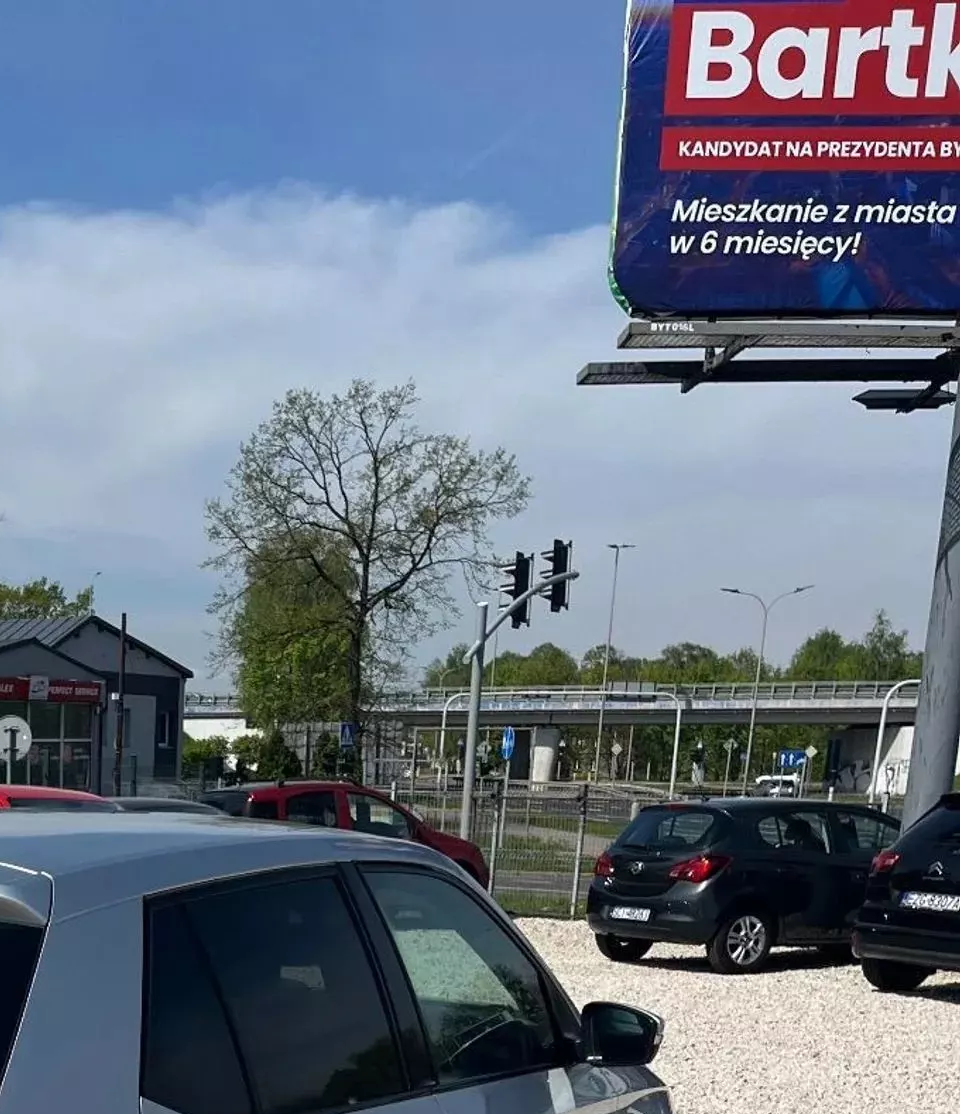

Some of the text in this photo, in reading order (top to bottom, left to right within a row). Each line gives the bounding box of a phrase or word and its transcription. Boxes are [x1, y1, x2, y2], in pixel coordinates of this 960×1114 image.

[678, 141, 782, 157] KANDYDAT
[786, 141, 811, 157] NA
[817, 141, 935, 157] PREZYDENTA
[671, 198, 956, 224] Mieszkanie z miasta
[670, 231, 862, 261] w 6 miesięcy!
